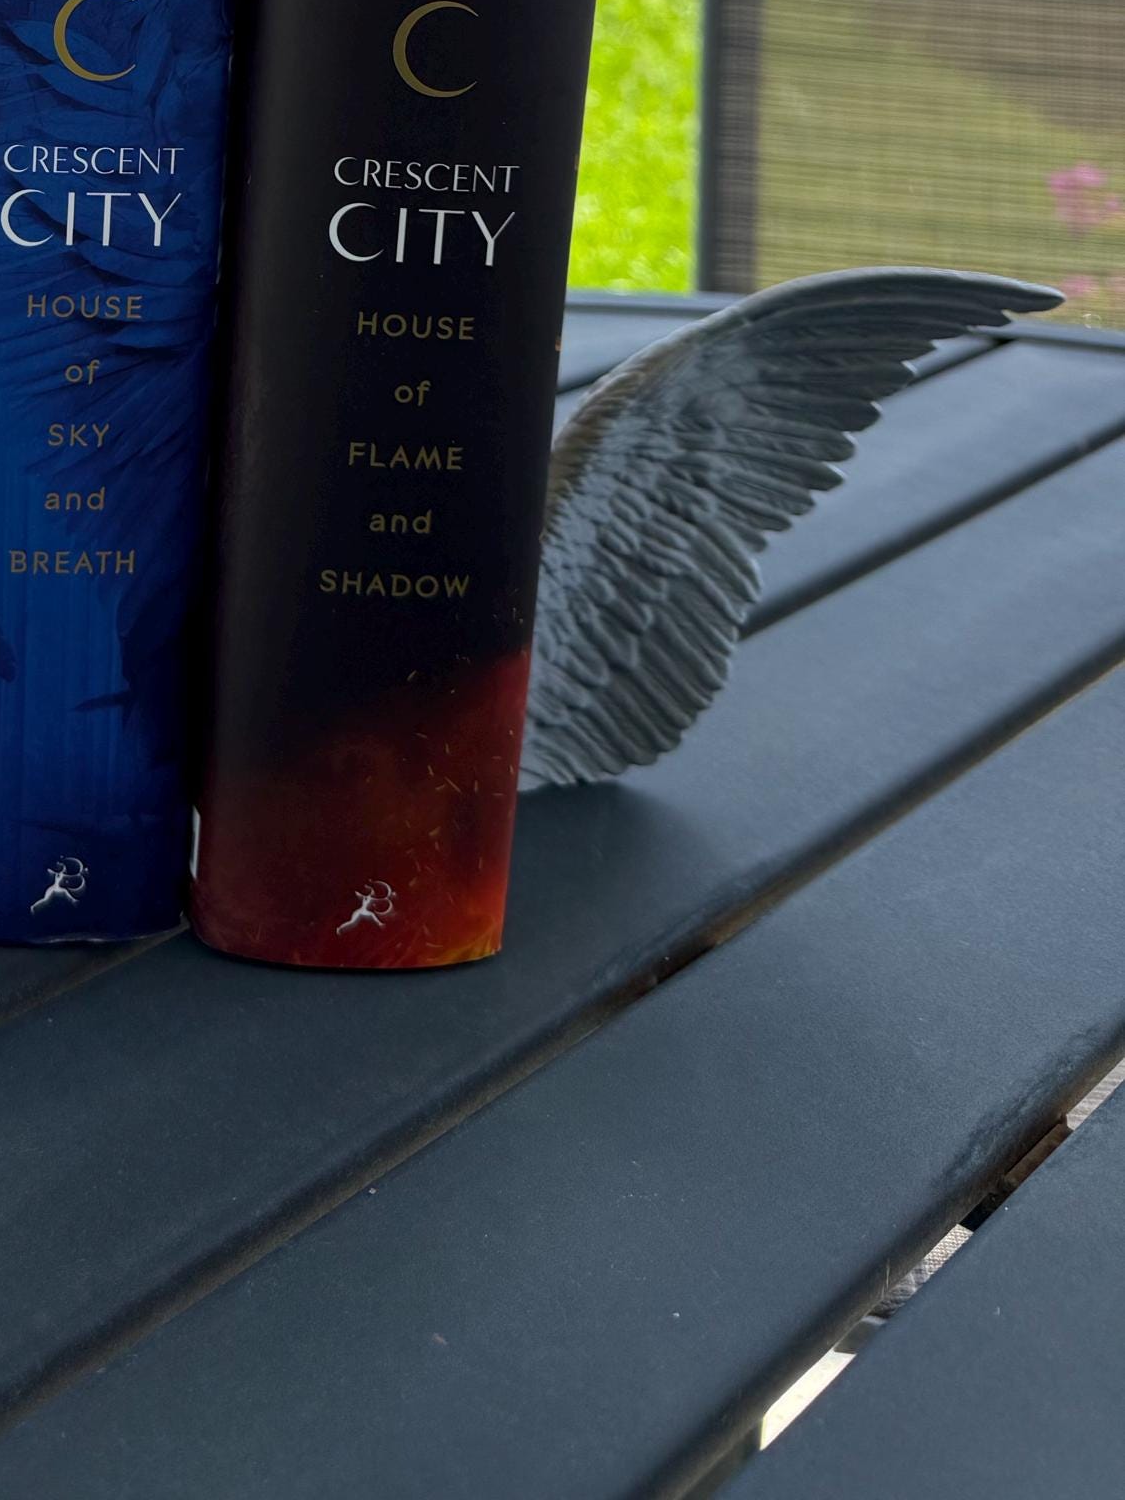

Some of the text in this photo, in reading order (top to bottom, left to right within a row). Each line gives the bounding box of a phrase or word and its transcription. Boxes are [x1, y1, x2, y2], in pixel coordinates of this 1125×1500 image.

[3, 144, 184, 175] CRESCENT
[333, 156, 520, 193] CRESCENT
[0, 188, 182, 247] CITY
[328, 202, 516, 267] CITY
[26, 294, 143, 319] HOUSE
[357, 311, 475, 341] HOUSE
[64, 359, 101, 385] of
[394, 379, 432, 407] of
[47, 423, 110, 448] SKY
[348, 441, 464, 471] FLAME
[43, 486, 106, 511] and
[369, 509, 432, 534] and
[7, 549, 135, 576] BREATH
[319, 569, 470, 598] SHADOW
